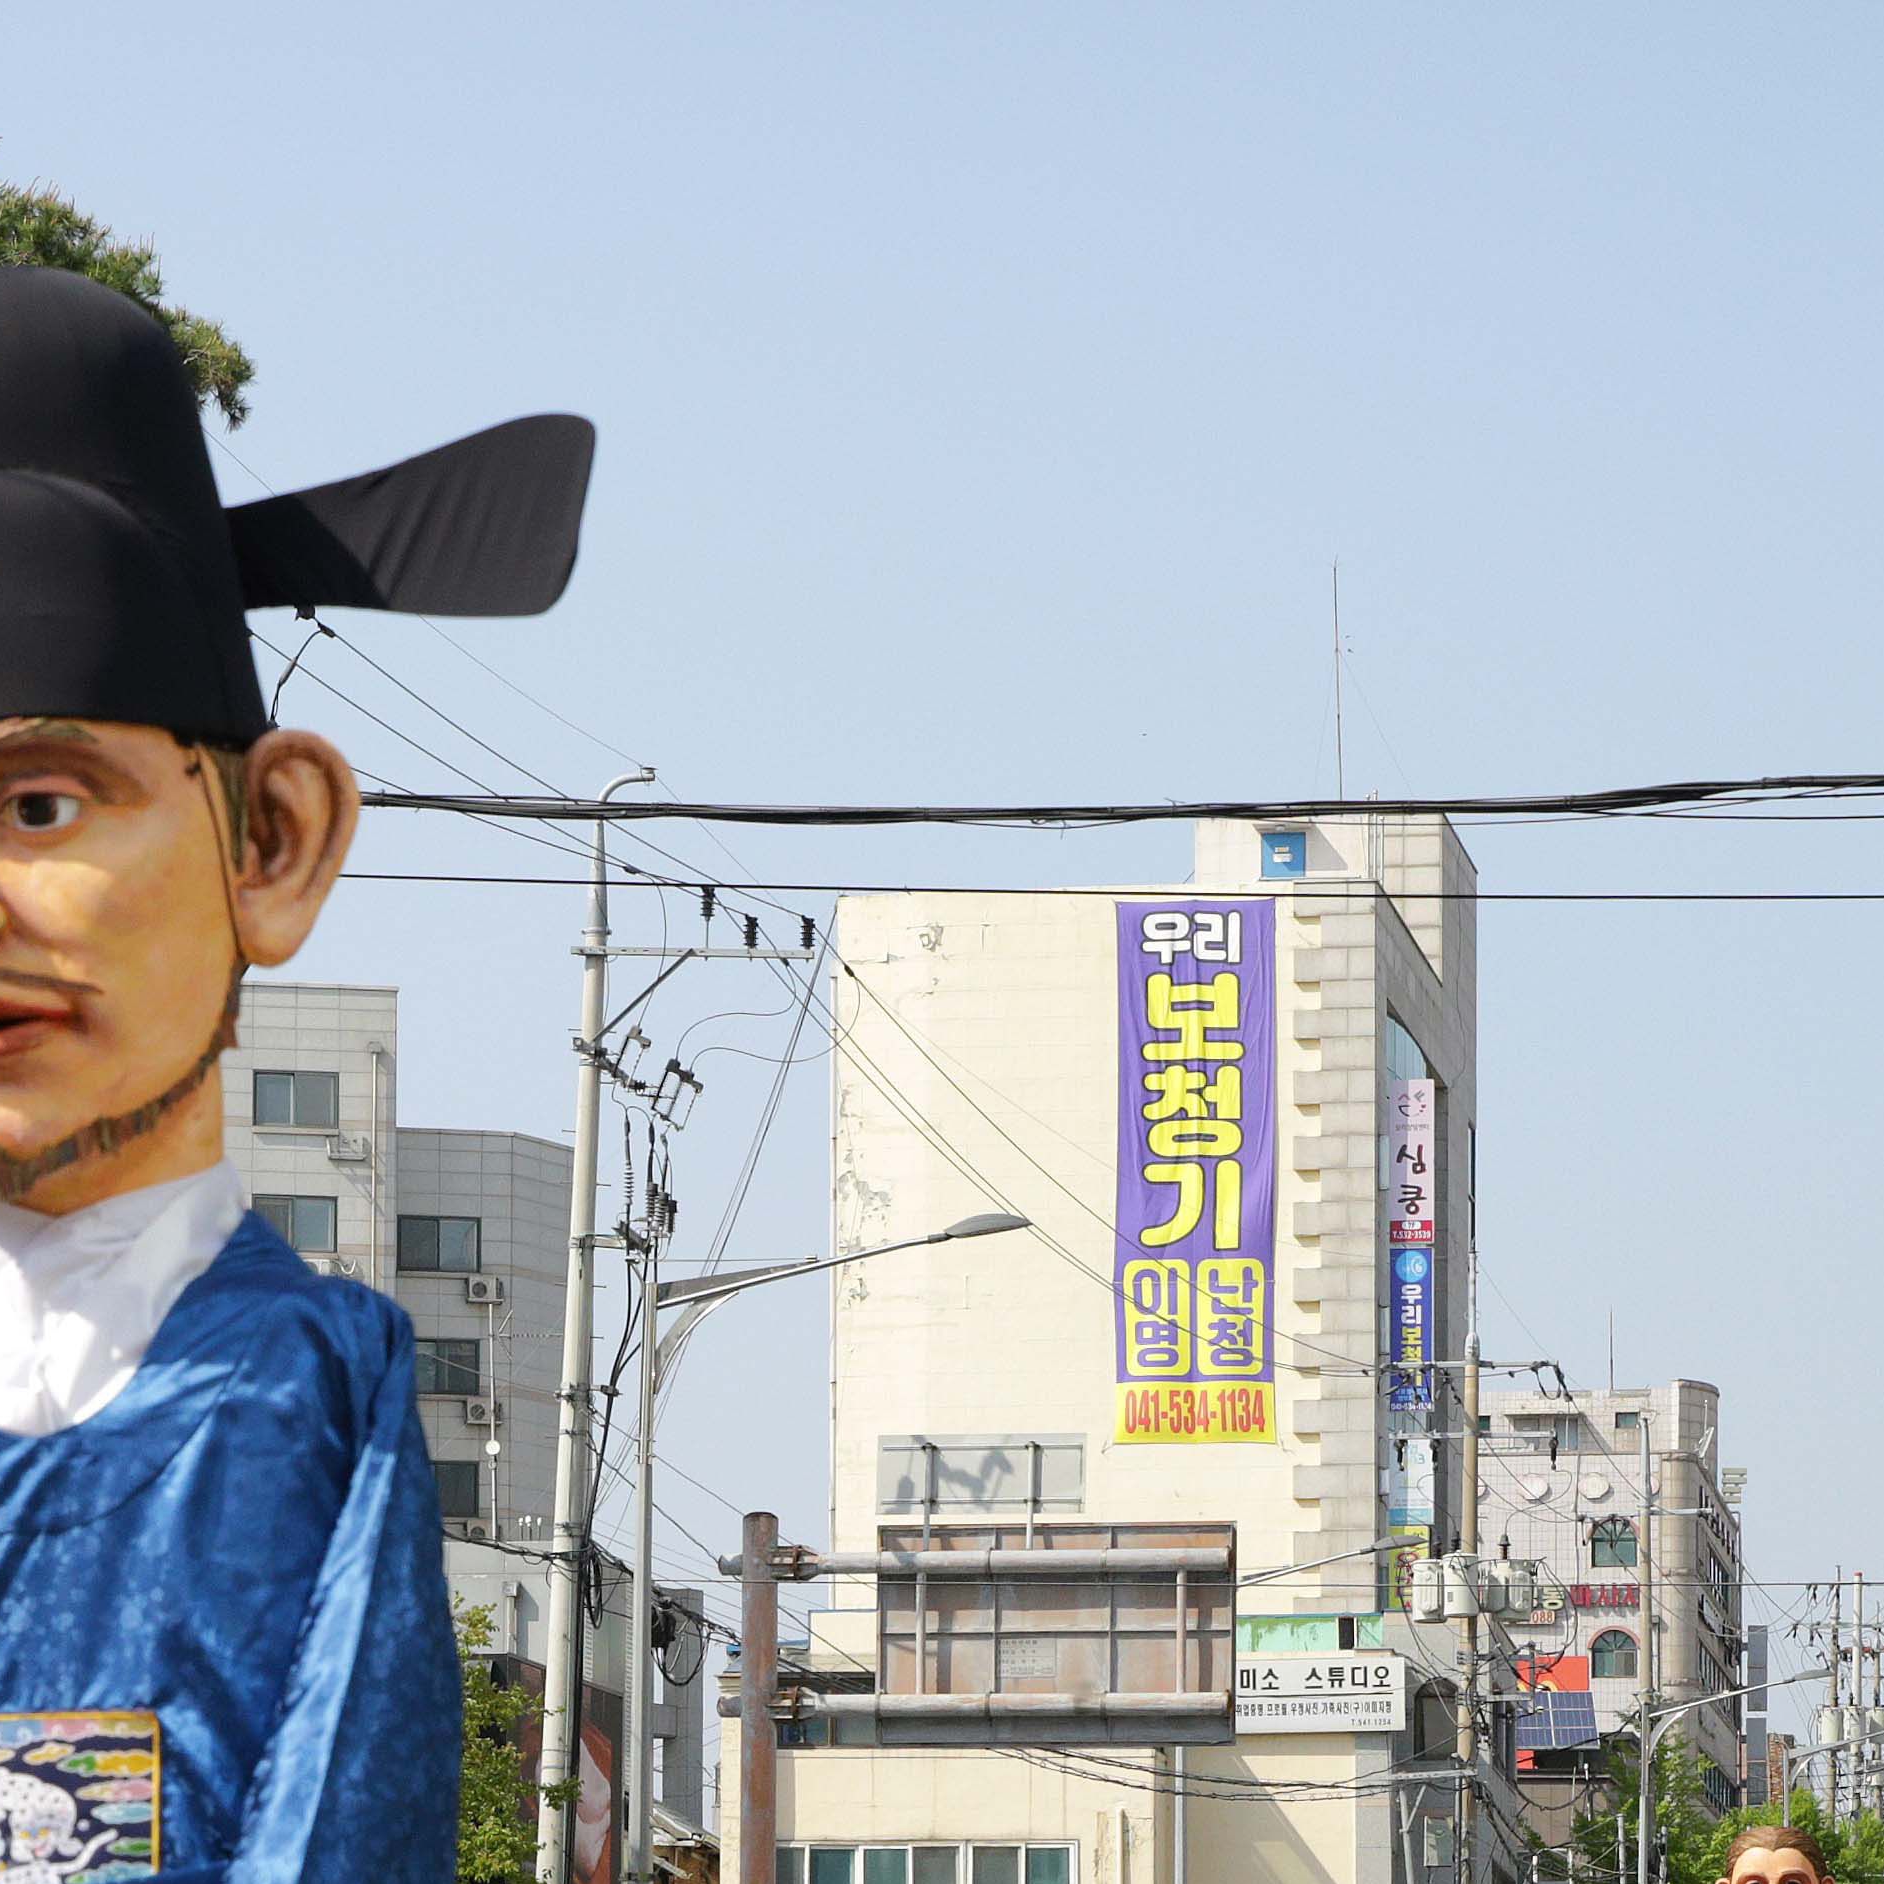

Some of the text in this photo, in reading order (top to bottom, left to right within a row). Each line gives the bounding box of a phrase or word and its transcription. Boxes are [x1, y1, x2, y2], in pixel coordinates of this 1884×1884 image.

[1141, 911, 1242, 965] 우리
[1141, 972, 1245, 1250] 보청기
[1132, 1267, 1258, 1368] 이명 난청
[1124, 1389, 1266, 1435] 041-534-1134
[1240, 1666, 1391, 1690] 미소 스튜디오
